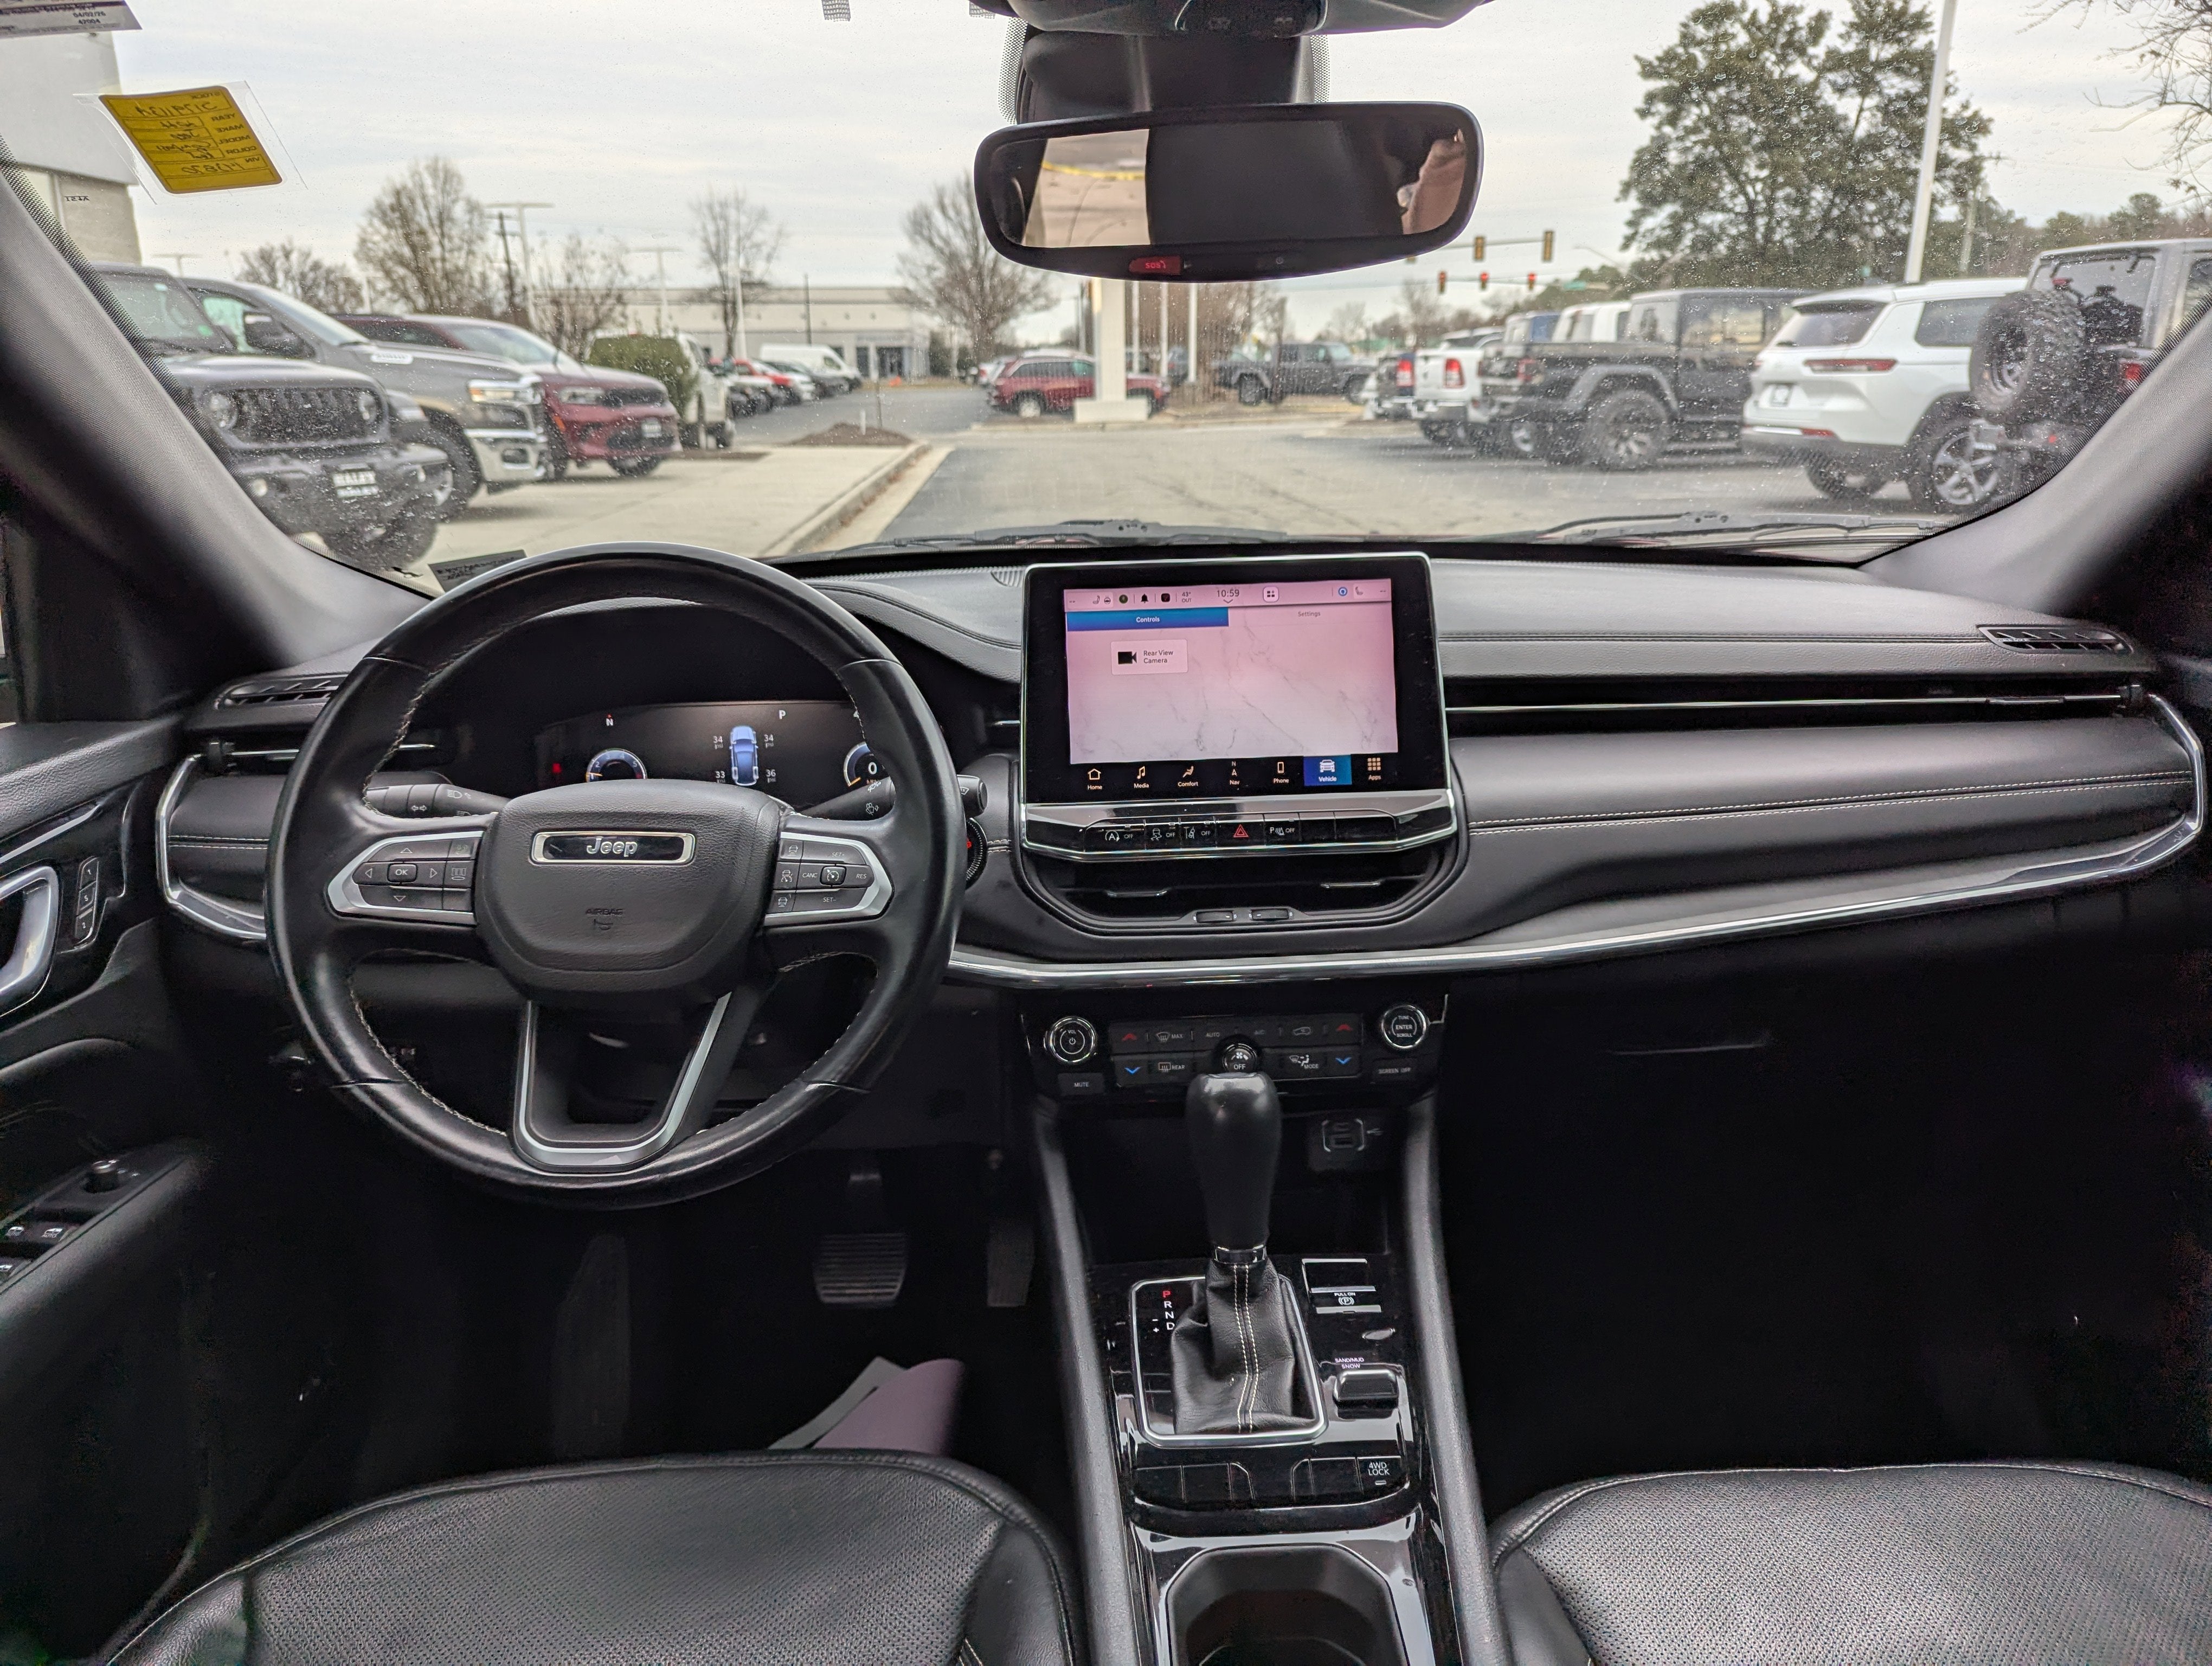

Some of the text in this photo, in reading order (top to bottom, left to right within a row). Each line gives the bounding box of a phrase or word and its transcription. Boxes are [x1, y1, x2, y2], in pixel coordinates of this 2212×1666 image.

[1217, 589, 1239, 598] 10:59
[779, 710, 786, 719] P
[713, 735, 723, 744] 34
[764, 734, 774, 742] 34
[868, 762, 877, 774] 0
[586, 836, 638, 857] Jeep
[1163, 1300, 1172, 1309] R
